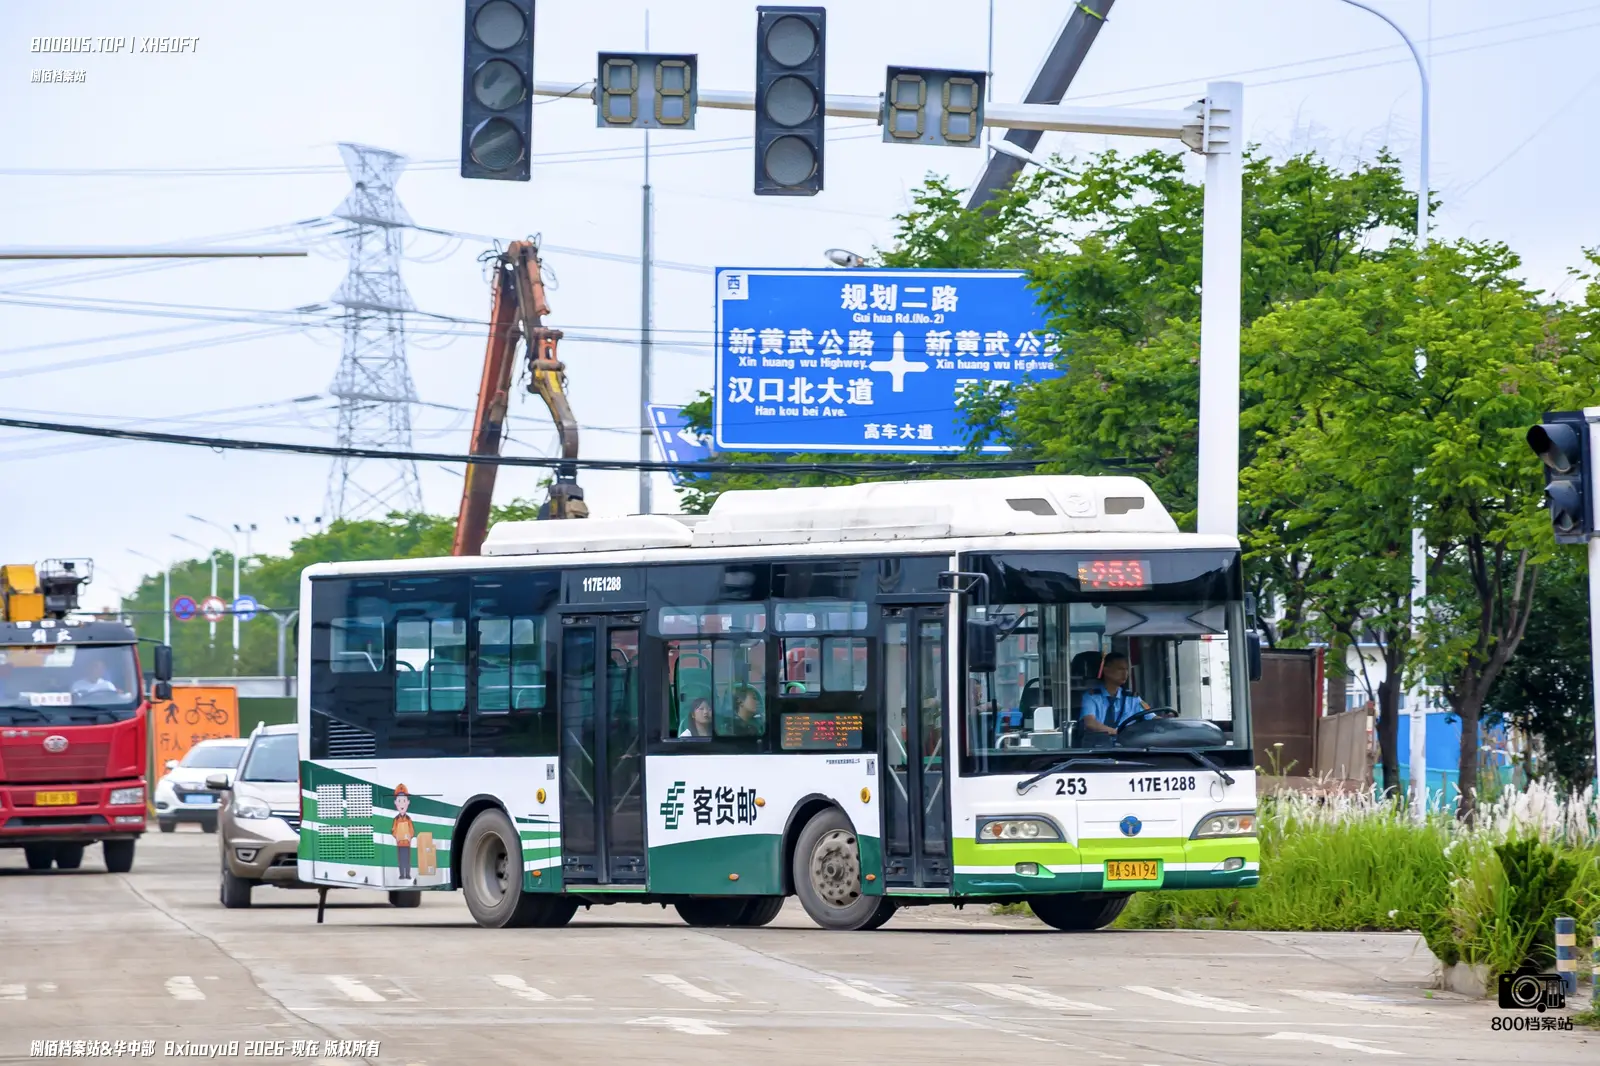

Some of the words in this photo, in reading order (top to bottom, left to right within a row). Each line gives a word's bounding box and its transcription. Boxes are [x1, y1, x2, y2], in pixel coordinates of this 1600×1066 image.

[726, 275, 741, 290] 西
[840, 283, 959, 312] 规划二路
[852, 312, 871, 323] Gui
[873, 312, 893, 323] hua
[728, 327, 875, 356] 新黄武公路
[738, 356, 757, 367] Xin
[762, 357, 795, 369] huang
[800, 359, 817, 368] wu
[936, 359, 954, 369] Xin
[957, 359, 990, 371] huang
[994, 360, 1011, 369] wu
[728, 376, 874, 405] 汉口北大道
[755, 405, 775, 416] Han
[779, 406, 799, 416] kou
[802, 406, 818, 416] bei
[822, 406, 847, 417] Ave.
[864, 423, 934, 440] 高车大道
[582, 576, 622, 592] 117E1288
[1055, 778, 1088, 796] 253
[1128, 776, 1196, 793] 117E1288
[693, 786, 758, 826] 客货邮
